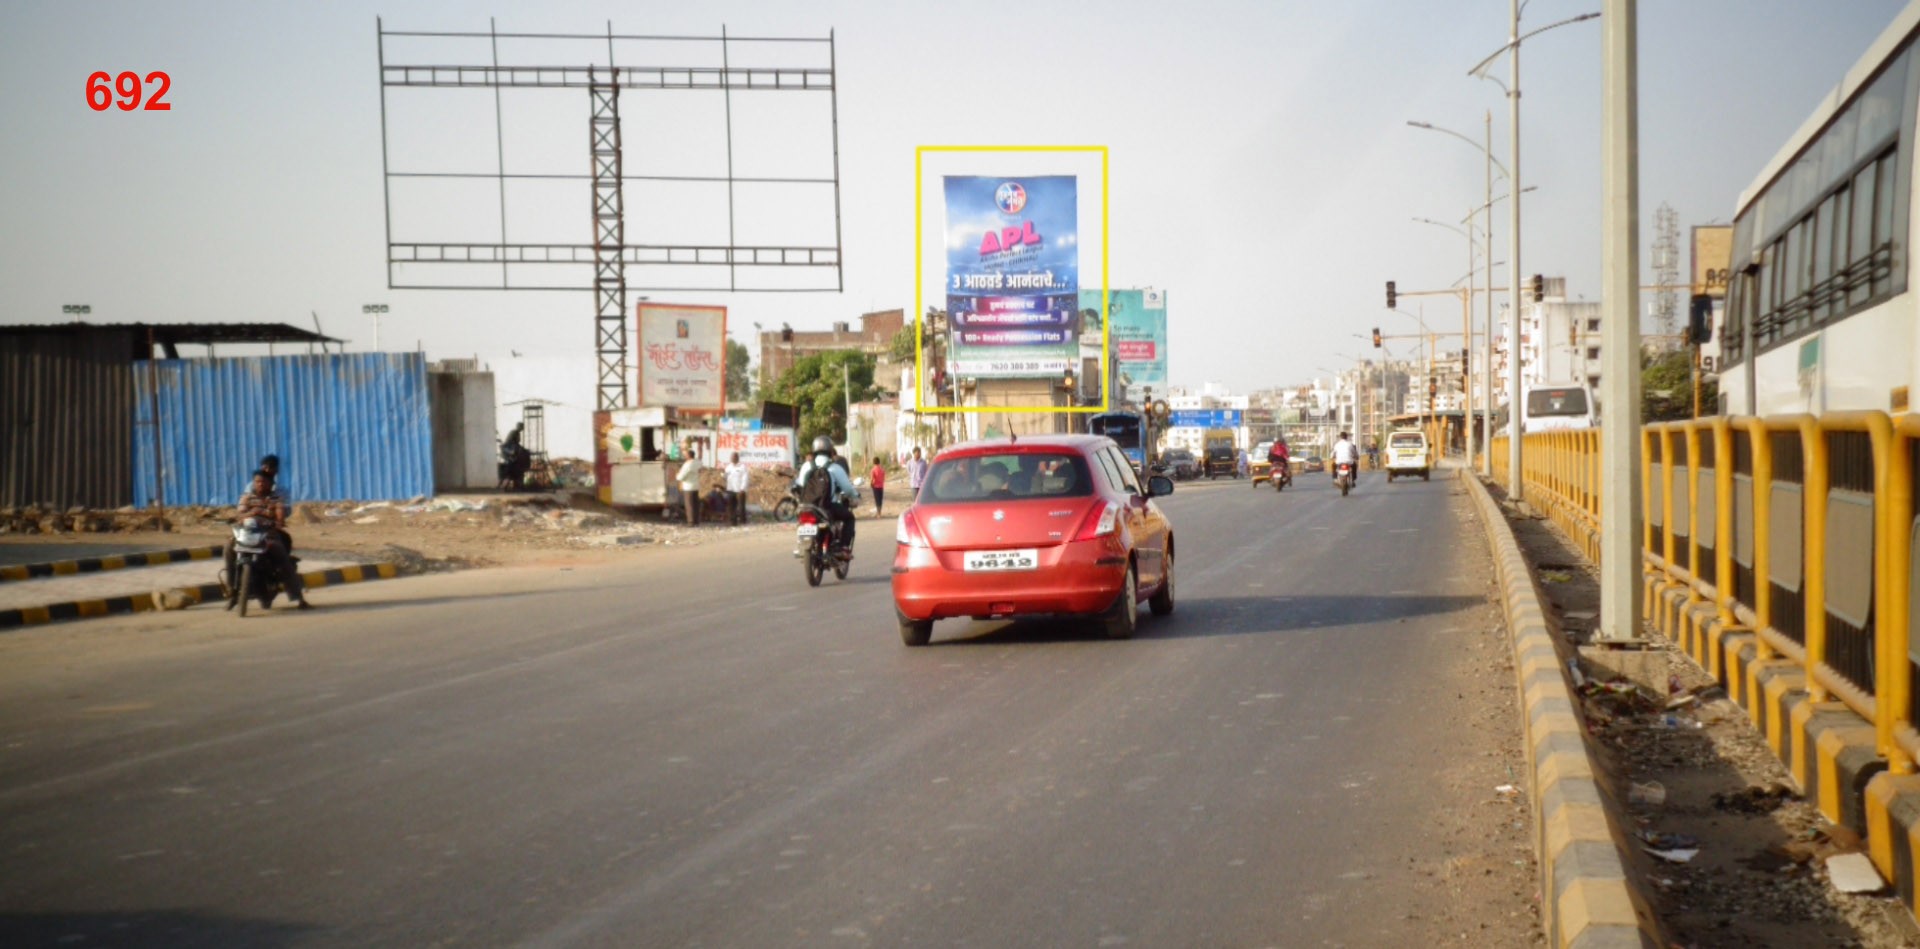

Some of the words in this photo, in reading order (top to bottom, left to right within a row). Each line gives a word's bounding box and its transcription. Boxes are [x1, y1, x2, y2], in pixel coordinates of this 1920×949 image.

[979, 219, 1042, 256] APL
[964, 271, 1003, 289] आठवडे
[1043, 332, 1060, 341] Flats
[971, 557, 1032, 569] 9642
